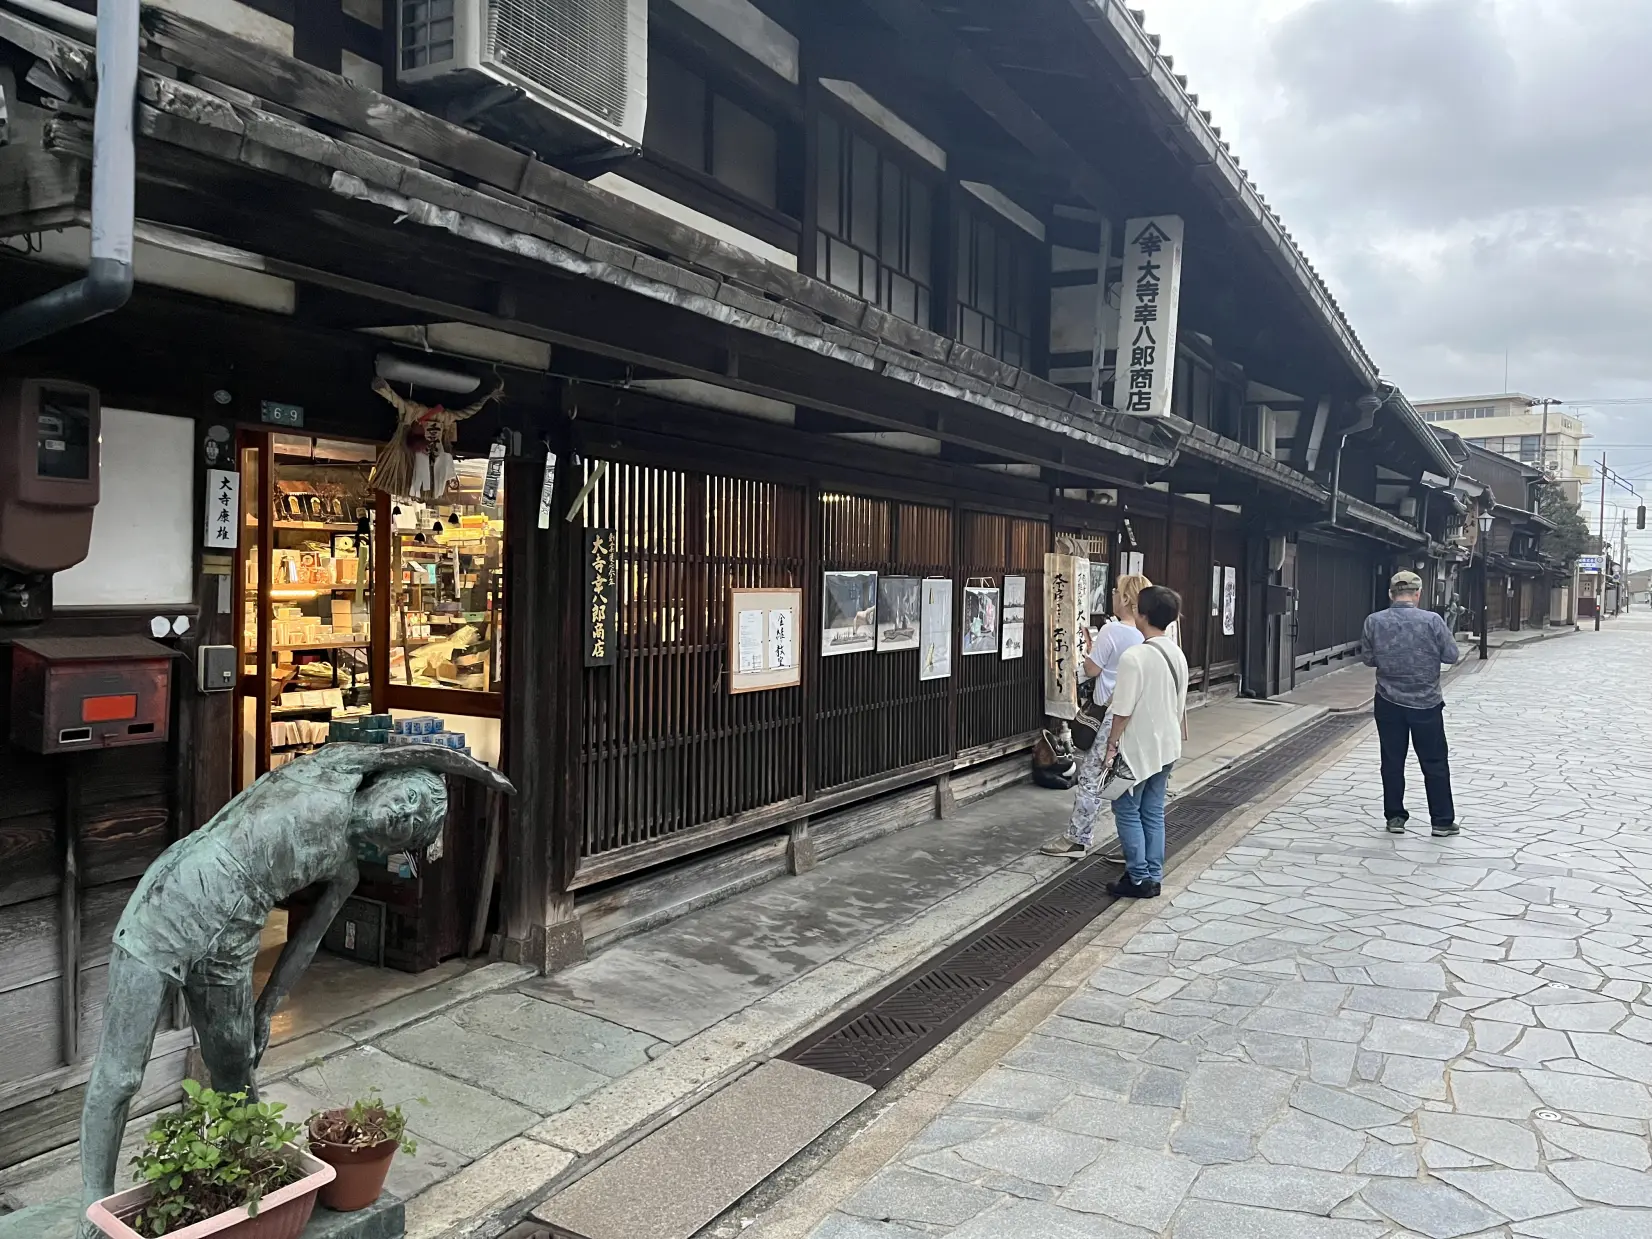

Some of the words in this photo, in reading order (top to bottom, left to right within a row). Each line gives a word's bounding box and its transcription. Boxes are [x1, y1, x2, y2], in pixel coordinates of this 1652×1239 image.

[1127, 260, 1161, 411] 大寺幸八郎商店
[216, 476, 233, 540] 大寺康雄
[591, 534, 608, 657] 大寺幸八郎商店
